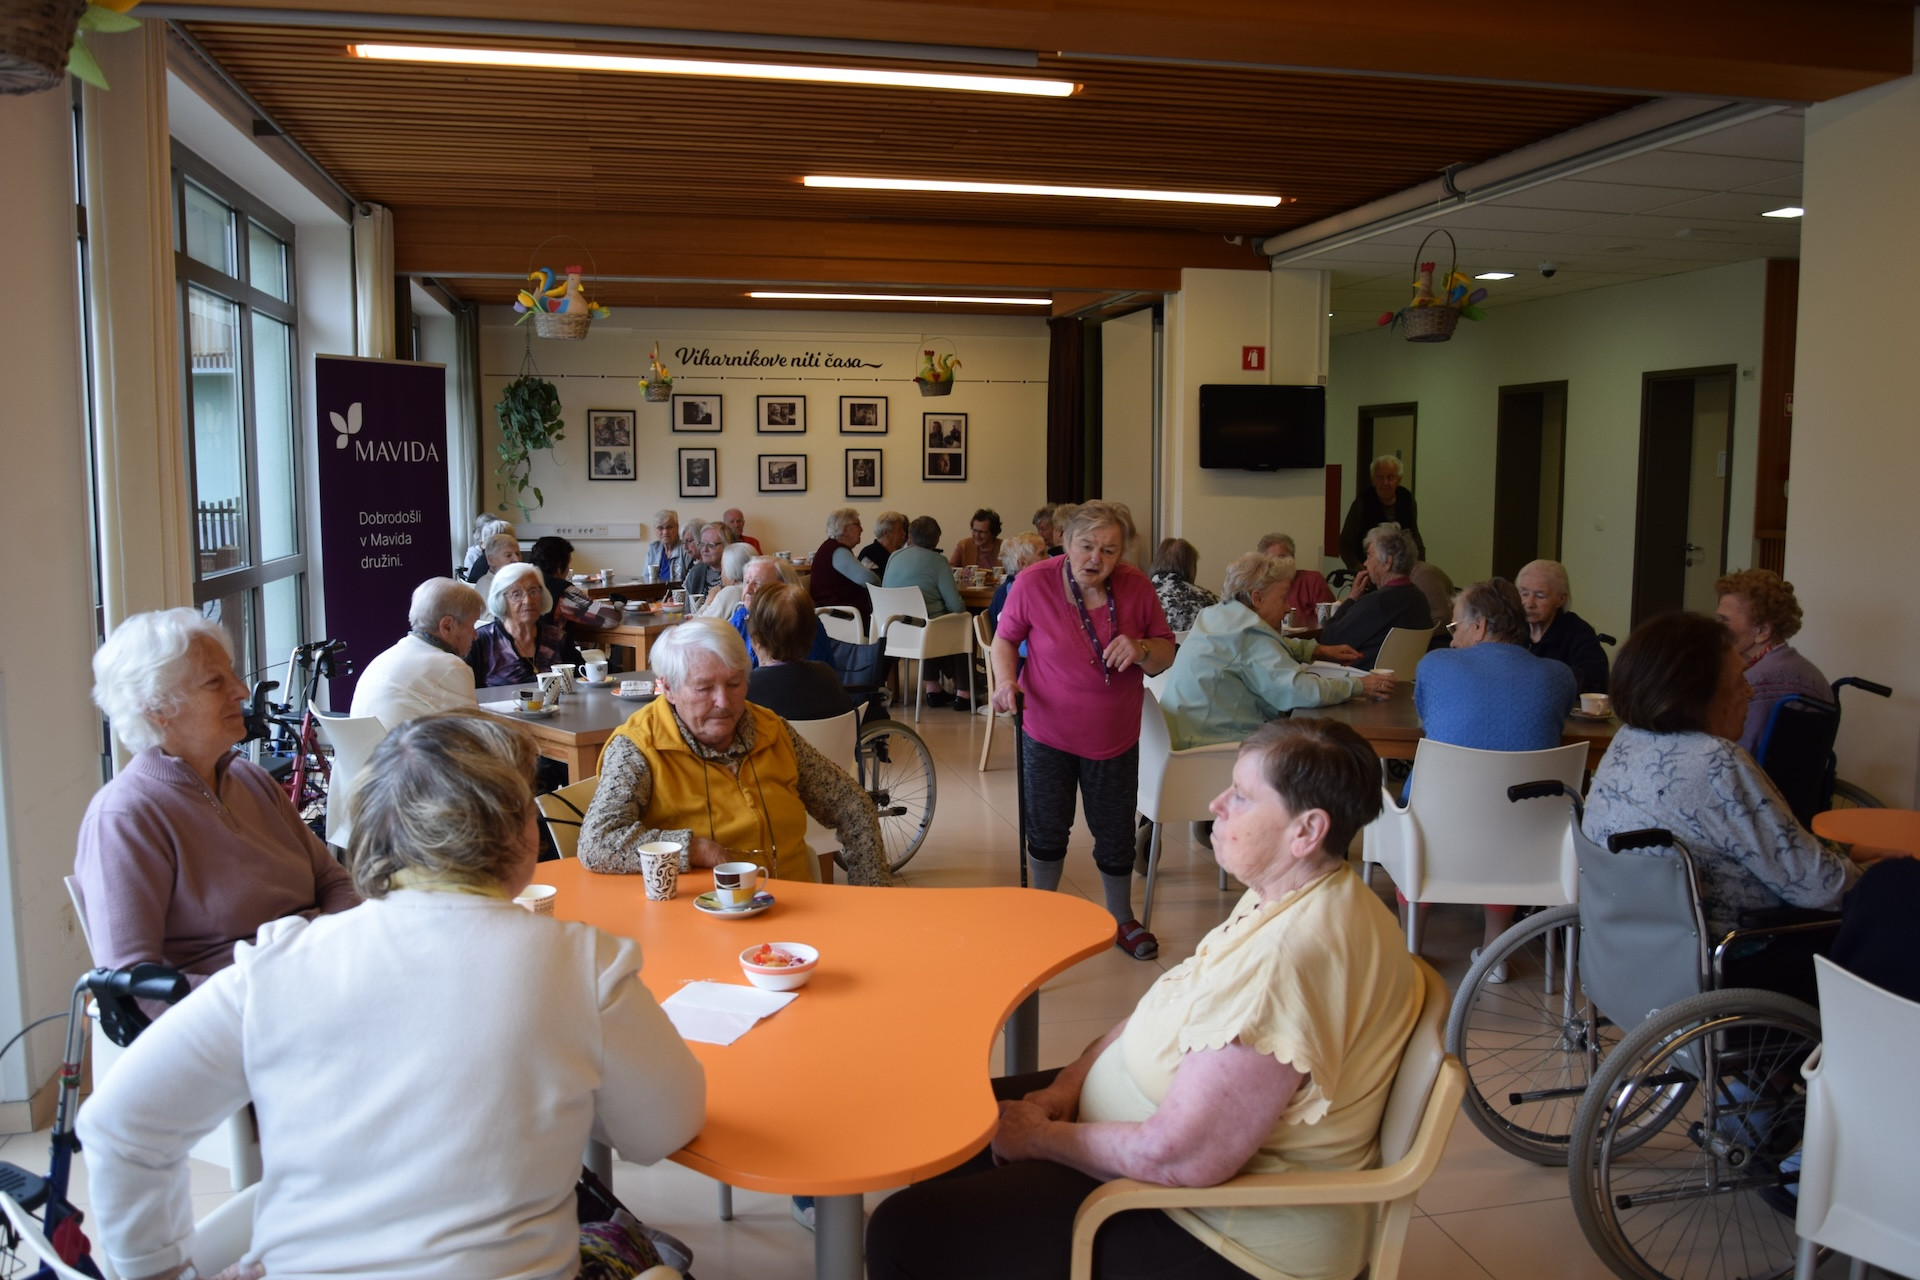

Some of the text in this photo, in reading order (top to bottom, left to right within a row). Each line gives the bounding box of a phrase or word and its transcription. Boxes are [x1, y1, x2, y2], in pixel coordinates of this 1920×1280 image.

[675, 347, 883, 368] Viharnikove niti časa
[355, 440, 440, 462] MAVIDA
[359, 509, 422, 525] Dobrodošli
[360, 532, 412, 547] v Mavida
[360, 553, 403, 569] družini.
